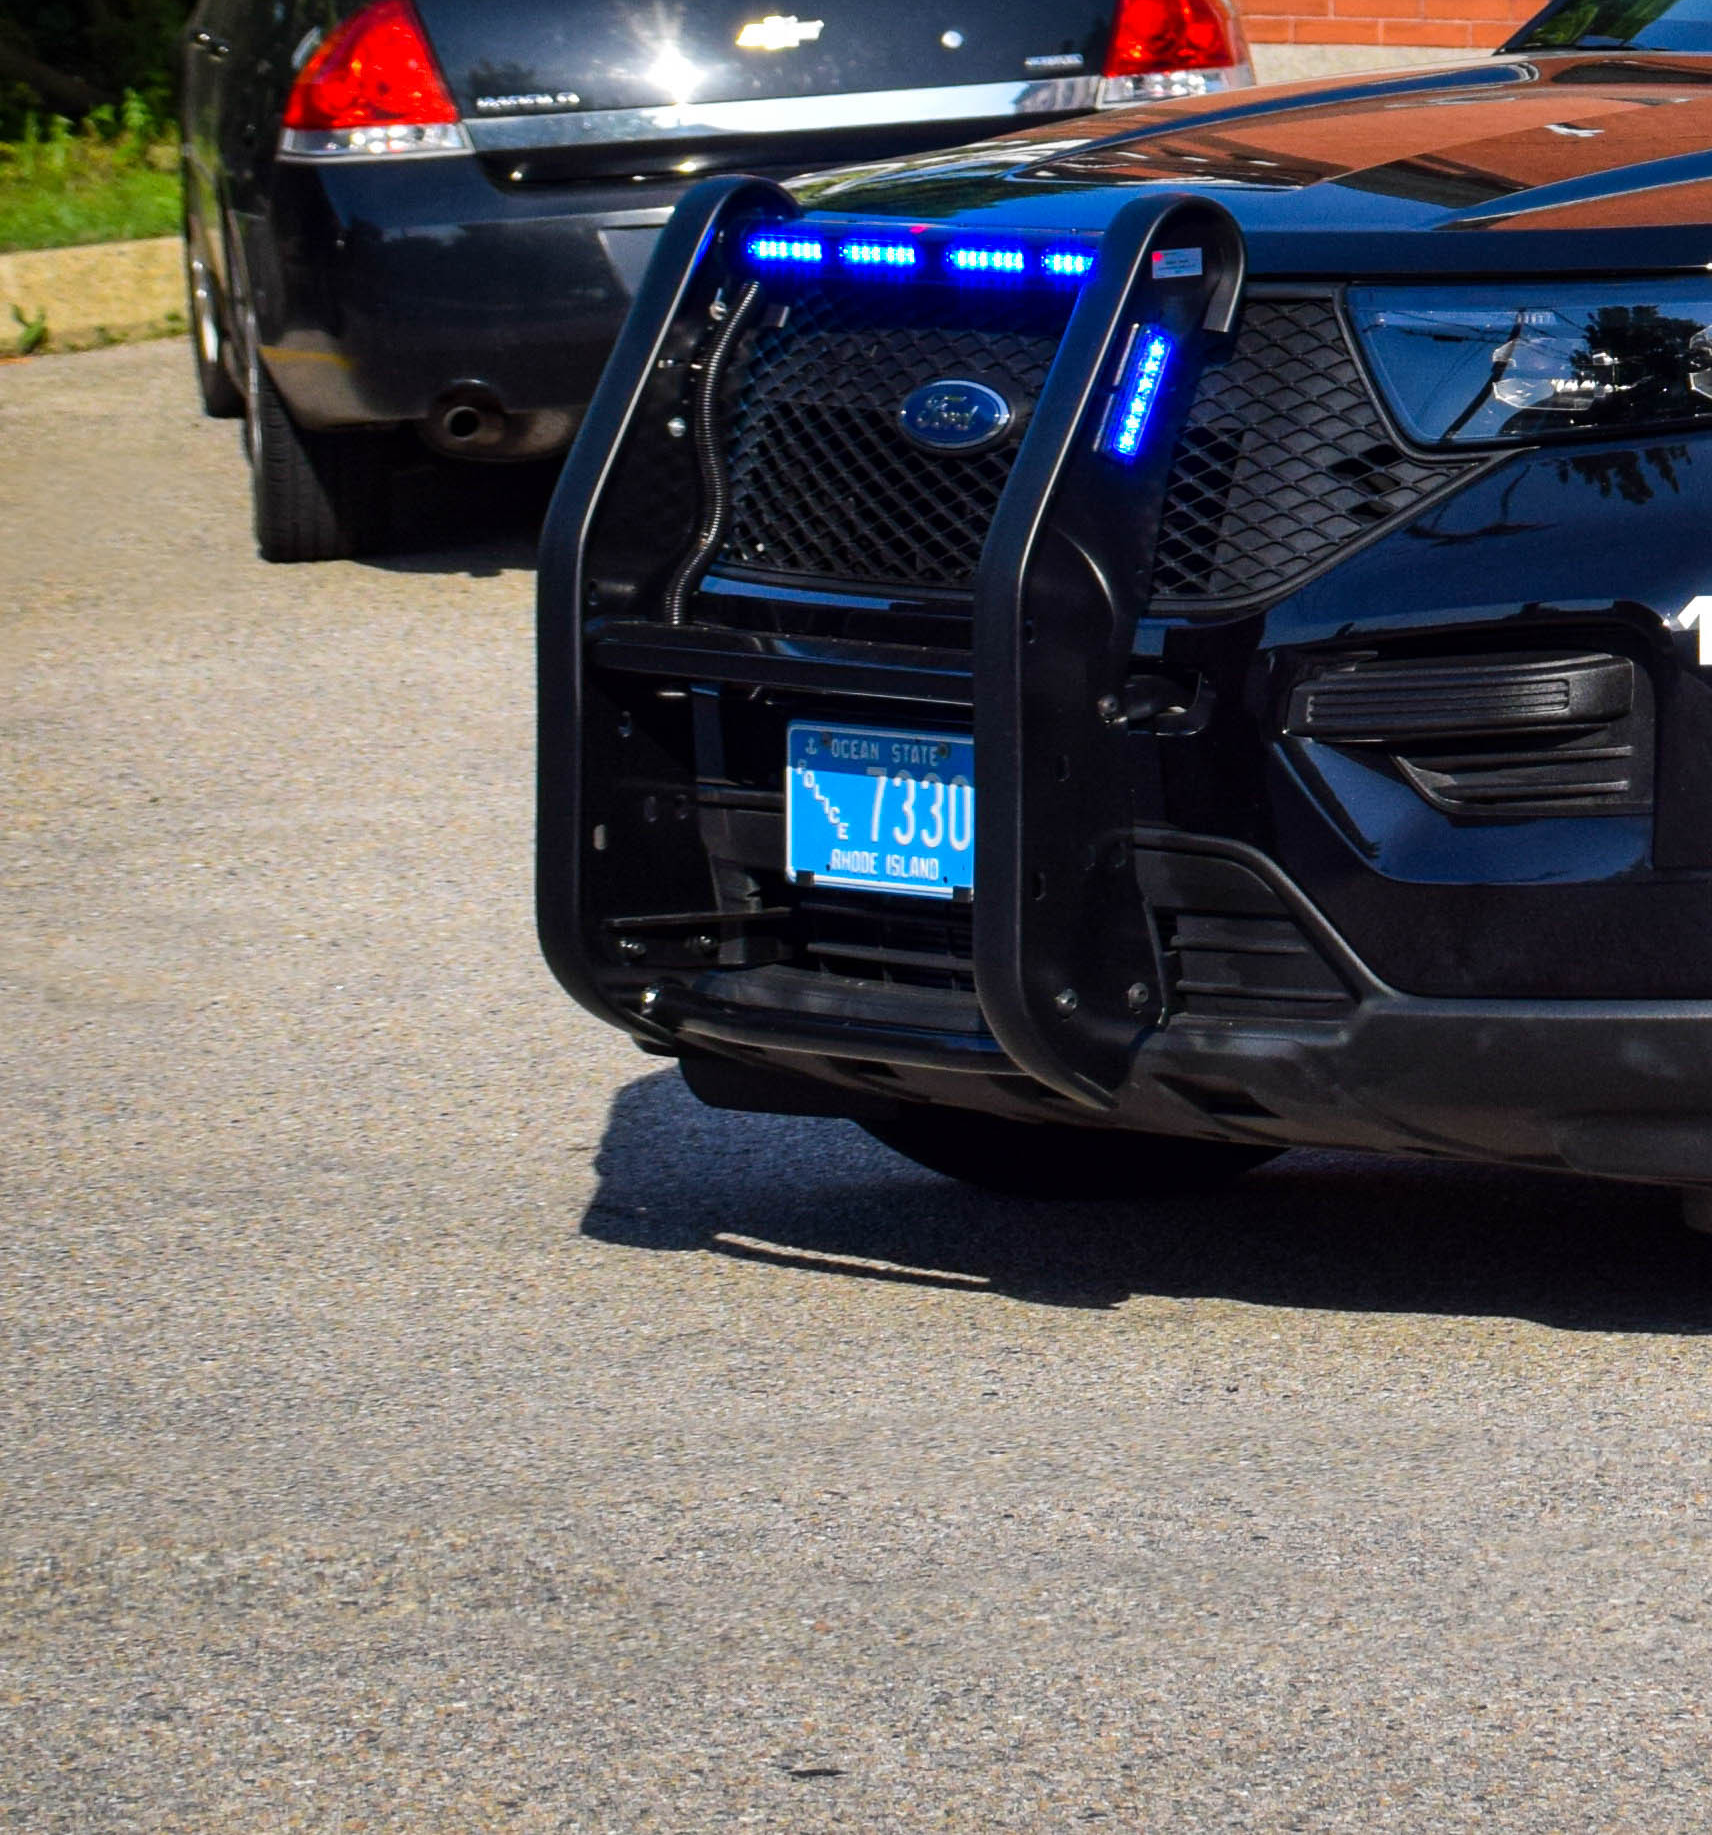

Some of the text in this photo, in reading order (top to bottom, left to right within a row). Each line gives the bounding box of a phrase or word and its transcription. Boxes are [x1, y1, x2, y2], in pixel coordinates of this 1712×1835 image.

[916, 394, 979, 431] Ford
[831, 738, 939, 767] OCEAN STATE
[796, 759, 850, 840] POLICE
[866, 767, 973, 851] 7330
[830, 848, 939, 880] RHODE ISLAND
